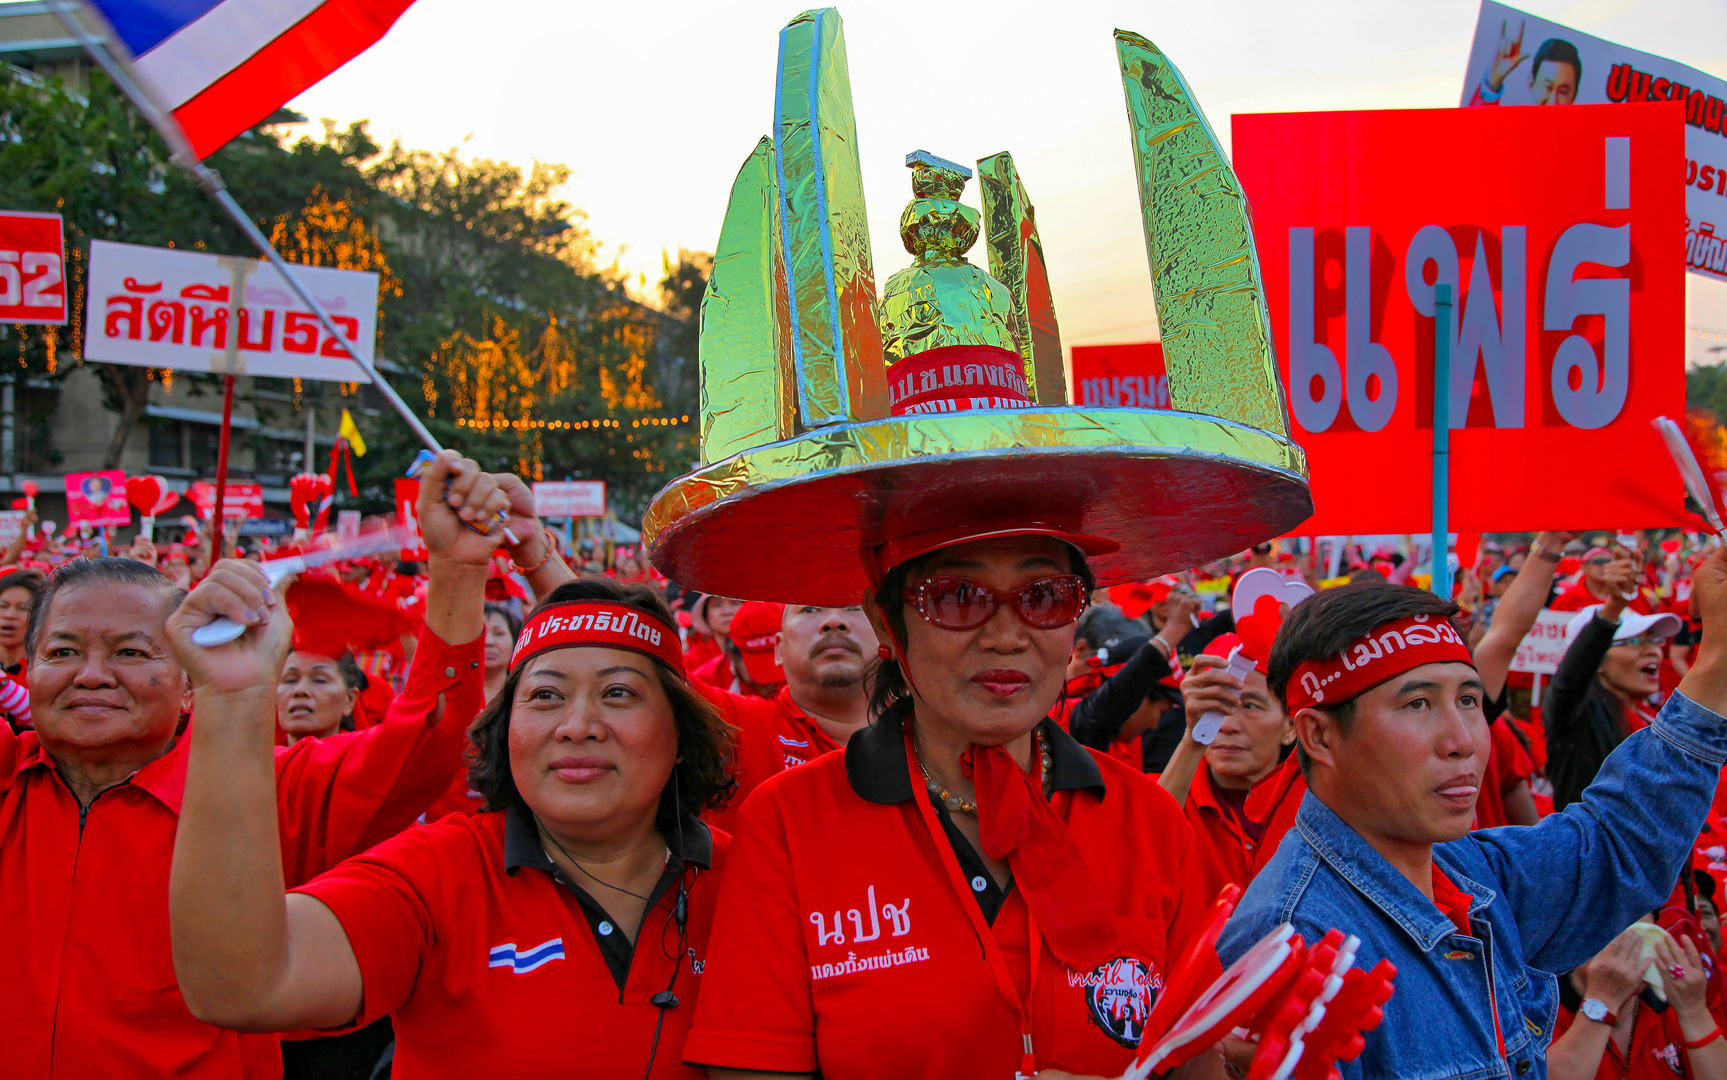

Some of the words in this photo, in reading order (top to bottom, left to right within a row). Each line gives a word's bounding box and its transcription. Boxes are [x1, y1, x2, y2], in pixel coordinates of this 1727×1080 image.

[1607, 63, 1727, 137] ชมรมคน
[0, 250, 63, 308] 52
[1288, 136, 1631, 433] แพร่
[104, 276, 359, 359] สัตหีบ52
[889, 363, 1028, 407] .ป.ช.แดงเดือ
[538, 611, 662, 647] ประชาธิปไตย
[1300, 613, 1463, 703] กู...ไม่กลัว
[809, 884, 911, 947] นปช
[811, 946, 930, 980] แดงทั้งแผ่นดิน
[1127, 959, 1164, 990] Toda
